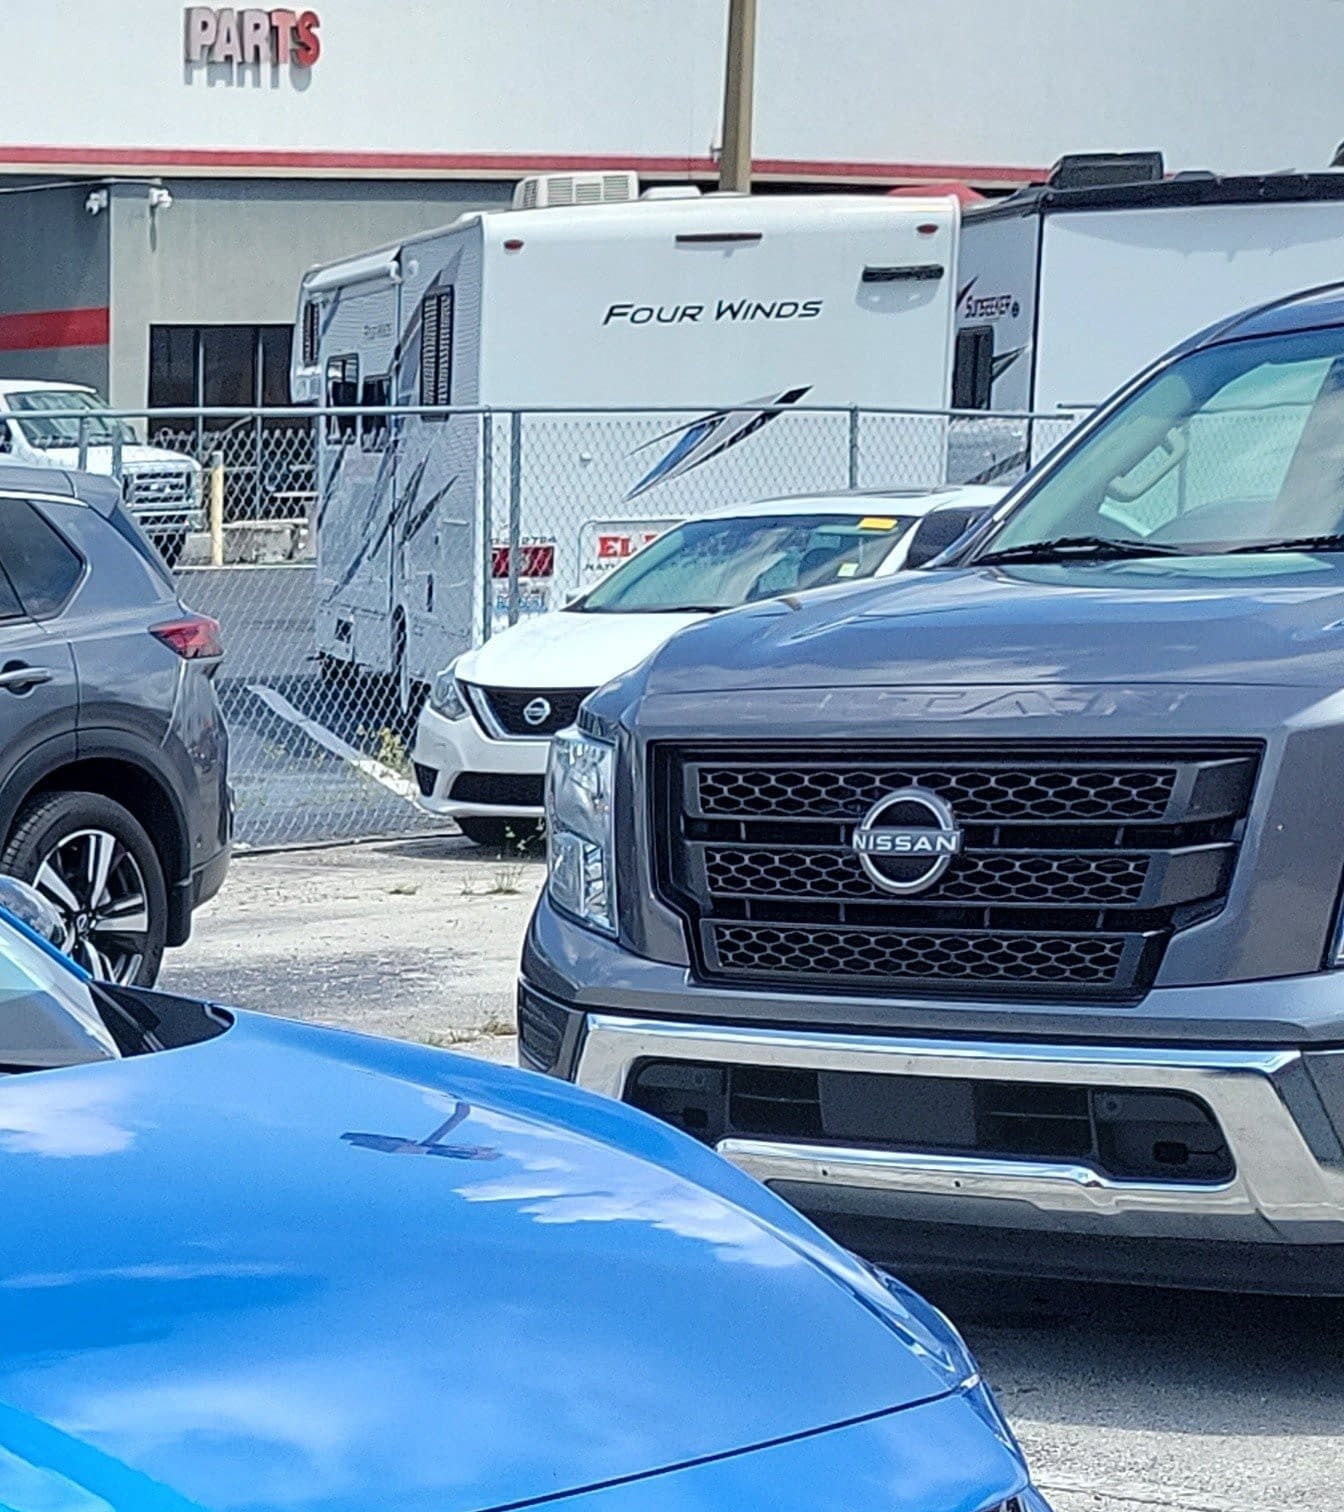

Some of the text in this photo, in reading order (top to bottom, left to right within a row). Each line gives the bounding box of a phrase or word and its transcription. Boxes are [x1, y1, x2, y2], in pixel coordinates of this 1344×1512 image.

[185, 7, 320, 67] PARTS
[603, 298, 823, 326] FOUR WINDS
[852, 835, 957, 851] NISSAN
